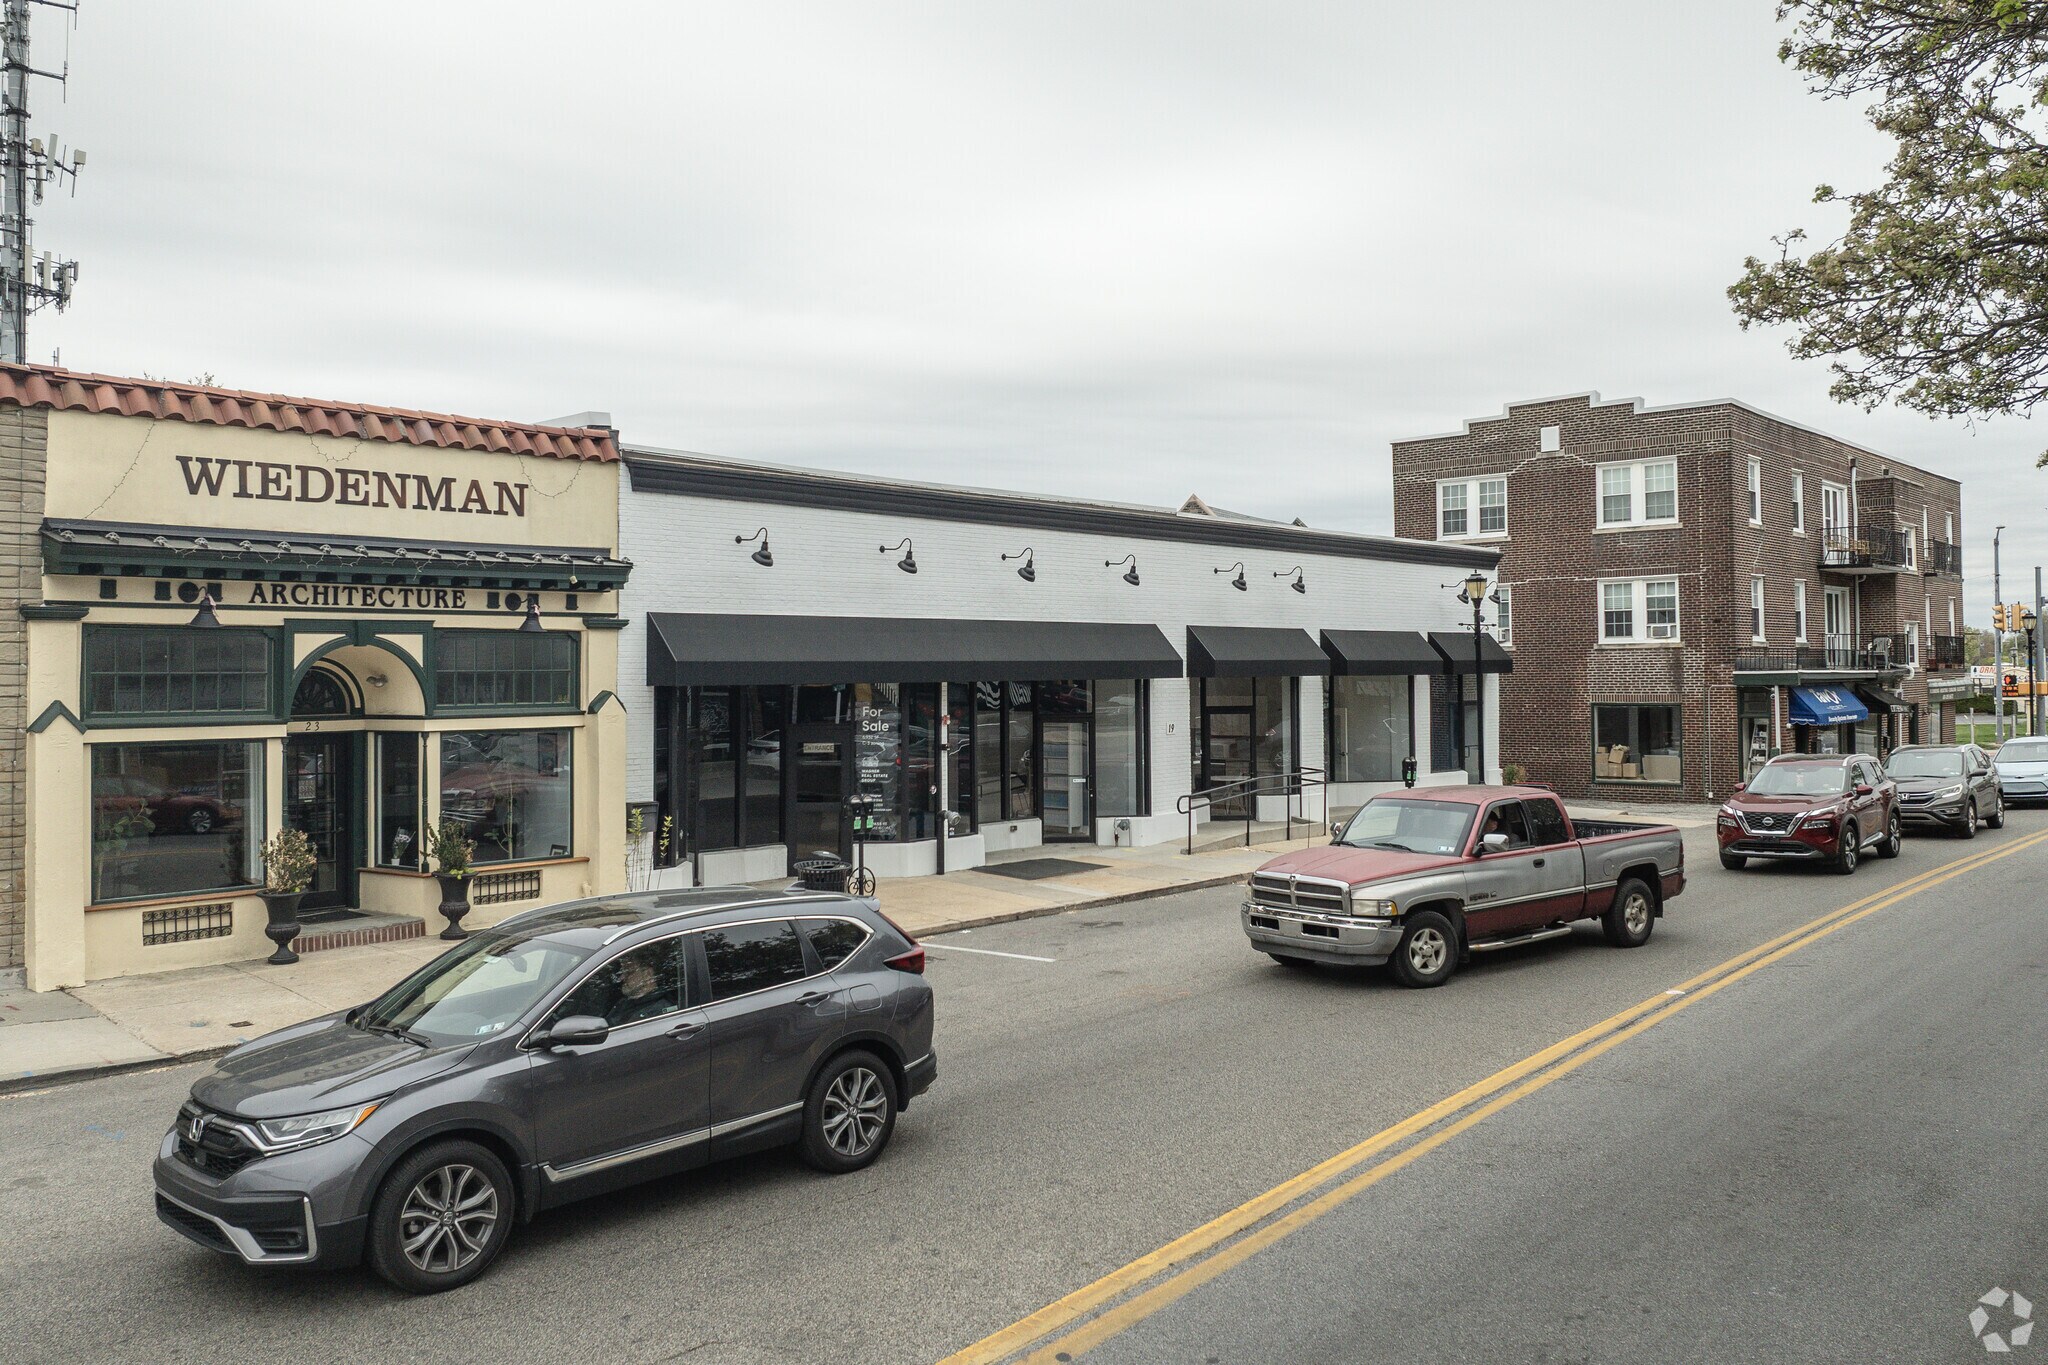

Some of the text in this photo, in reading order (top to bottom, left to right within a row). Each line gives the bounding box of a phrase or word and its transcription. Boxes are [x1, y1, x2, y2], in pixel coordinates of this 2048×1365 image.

[175, 454, 529, 517] WIEDENMAN
[248, 582, 467, 609] ARCHITECTURE
[862, 706, 883, 717] For
[306, 721, 320, 731] 23
[862, 720, 889, 732] Sale
[1168, 723, 1175, 733] 19
